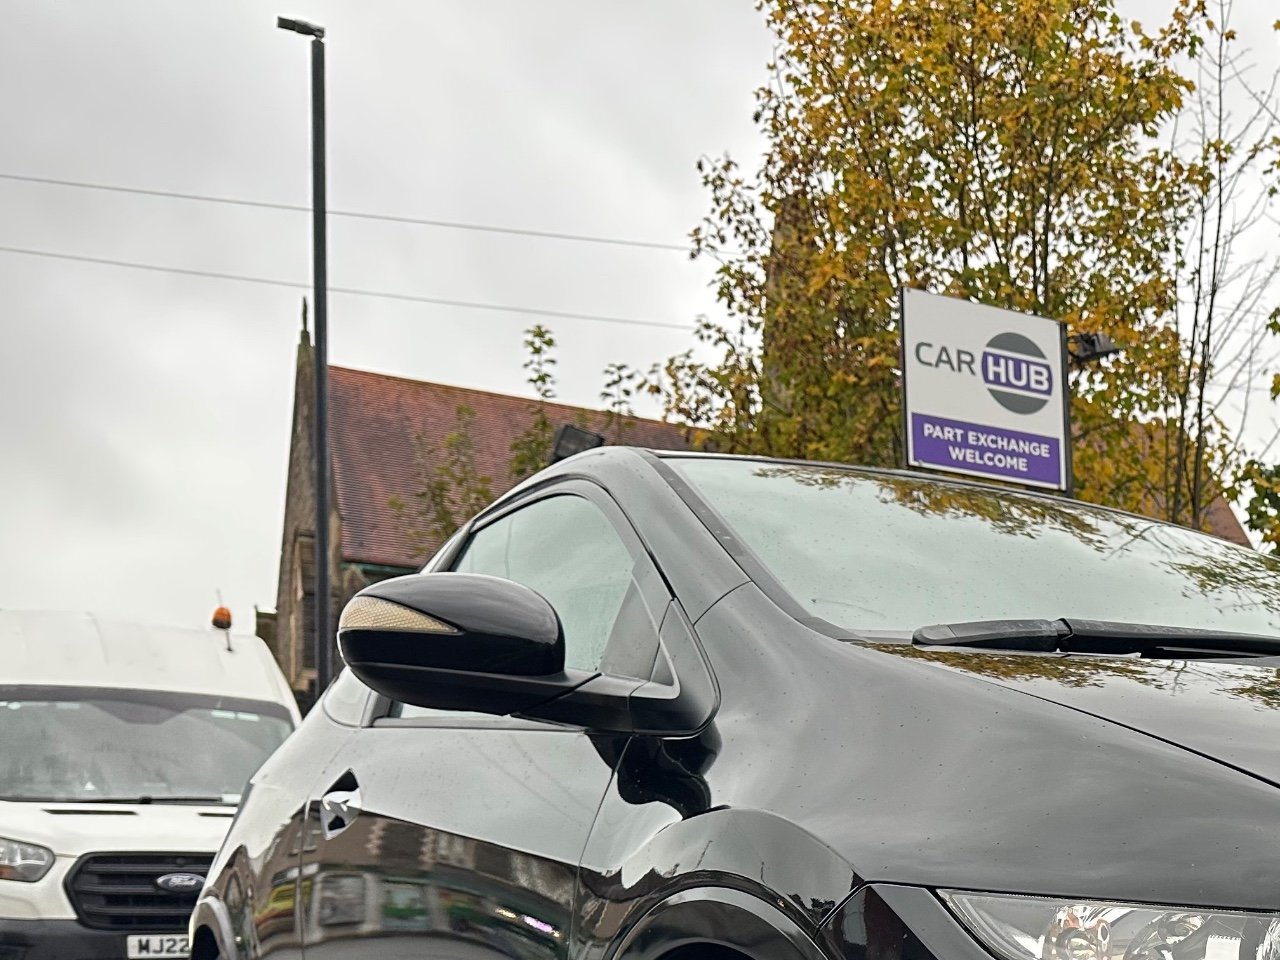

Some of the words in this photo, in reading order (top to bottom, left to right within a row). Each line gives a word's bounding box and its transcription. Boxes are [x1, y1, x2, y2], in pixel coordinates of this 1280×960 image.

[915, 341, 976, 375] CAR
[986, 354, 1049, 392] HUB
[923, 423, 964, 443] PART
[967, 432, 1051, 458] EXCHANGE
[948, 446, 1029, 472] WELCOME
